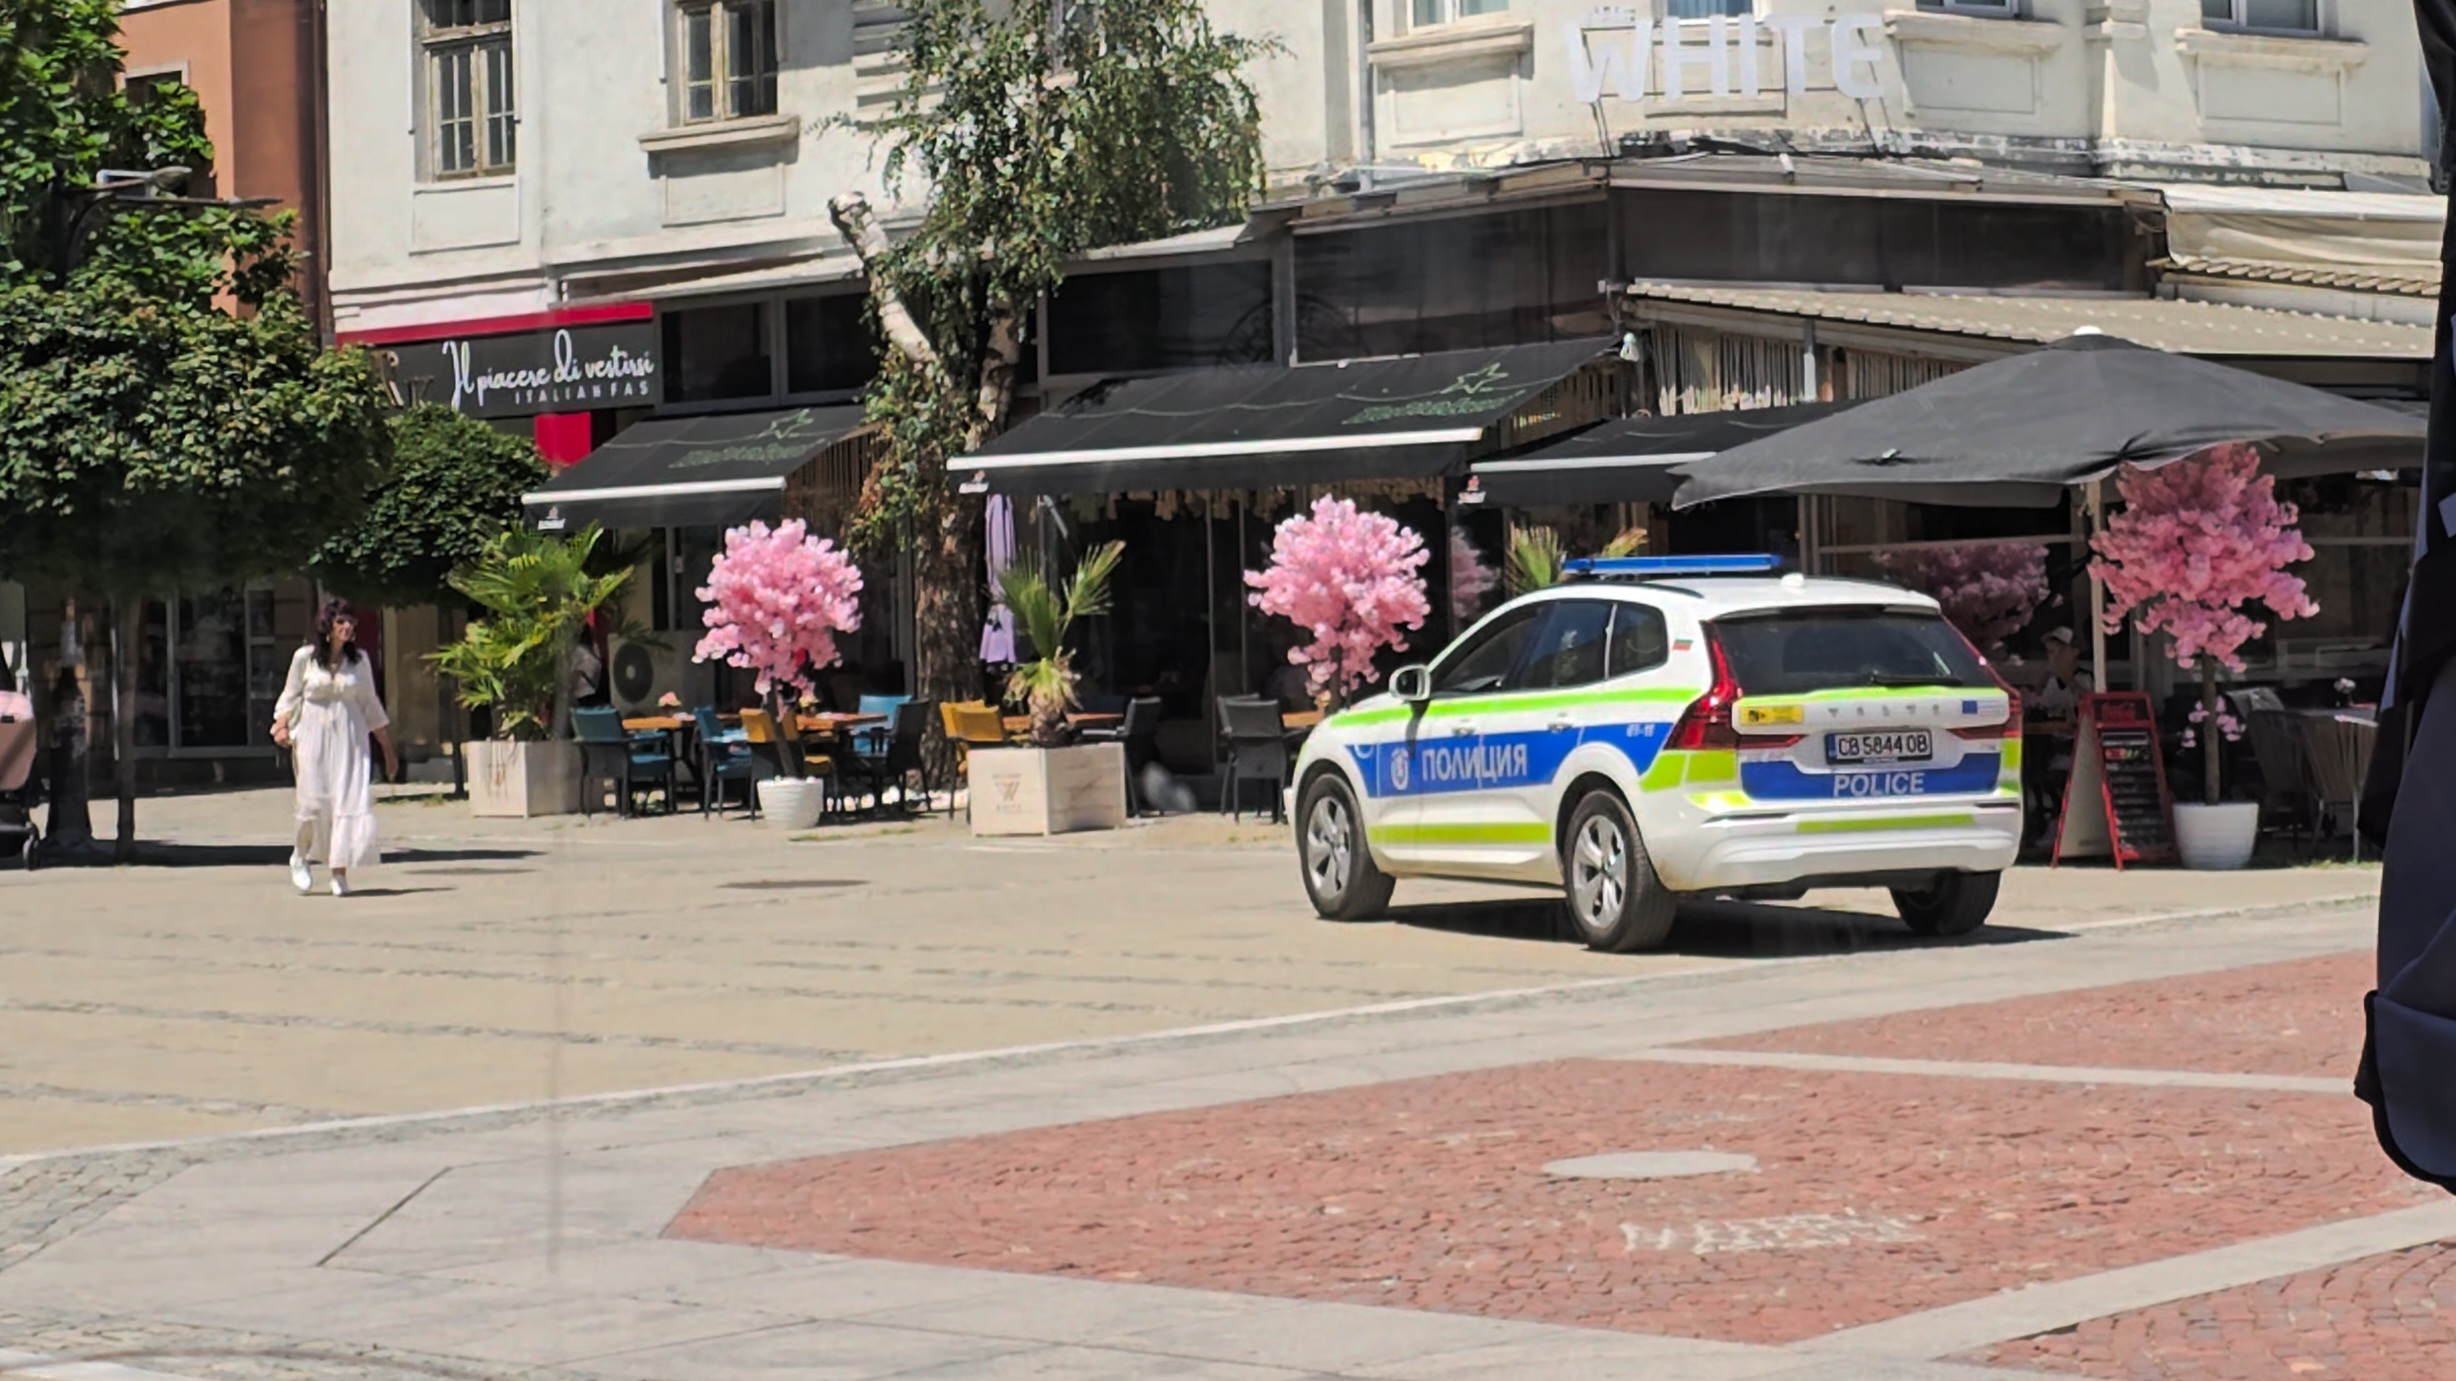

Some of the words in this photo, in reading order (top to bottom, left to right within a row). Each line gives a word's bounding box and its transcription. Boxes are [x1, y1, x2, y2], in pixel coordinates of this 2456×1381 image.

[1565, 11, 1886, 103] WHITE
[476, 366, 551, 407] piacere
[553, 328, 583, 383] di
[514, 383, 602, 405] ITALIAN
[1420, 743, 1528, 783] ПОЛИЦИЯ
[1833, 772, 1926, 797] POLICE
